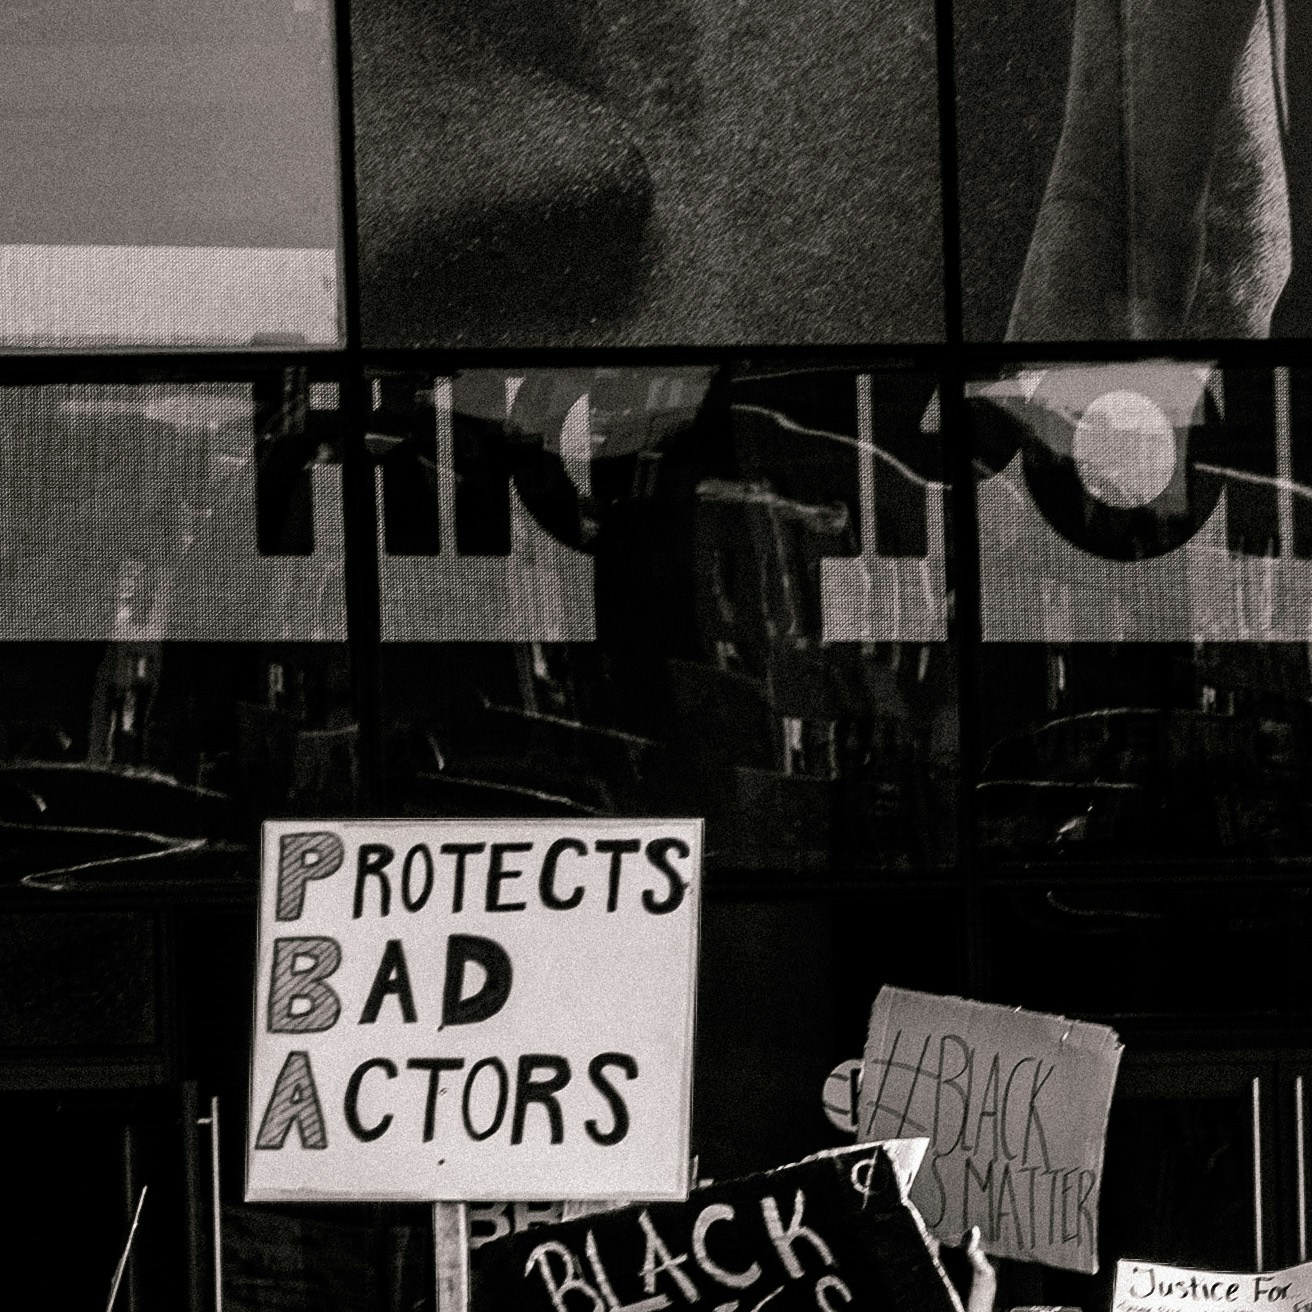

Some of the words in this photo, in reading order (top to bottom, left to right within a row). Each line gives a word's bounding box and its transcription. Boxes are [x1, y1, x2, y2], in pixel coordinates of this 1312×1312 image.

[274, 831, 691, 922] PROTECTS
[266, 934, 513, 1034] BAD
[254, 1050, 640, 1152] ACTORS
[962, 1155, 1098, 1257] MATTER
[1129, 1266, 1240, 1303] Justice
